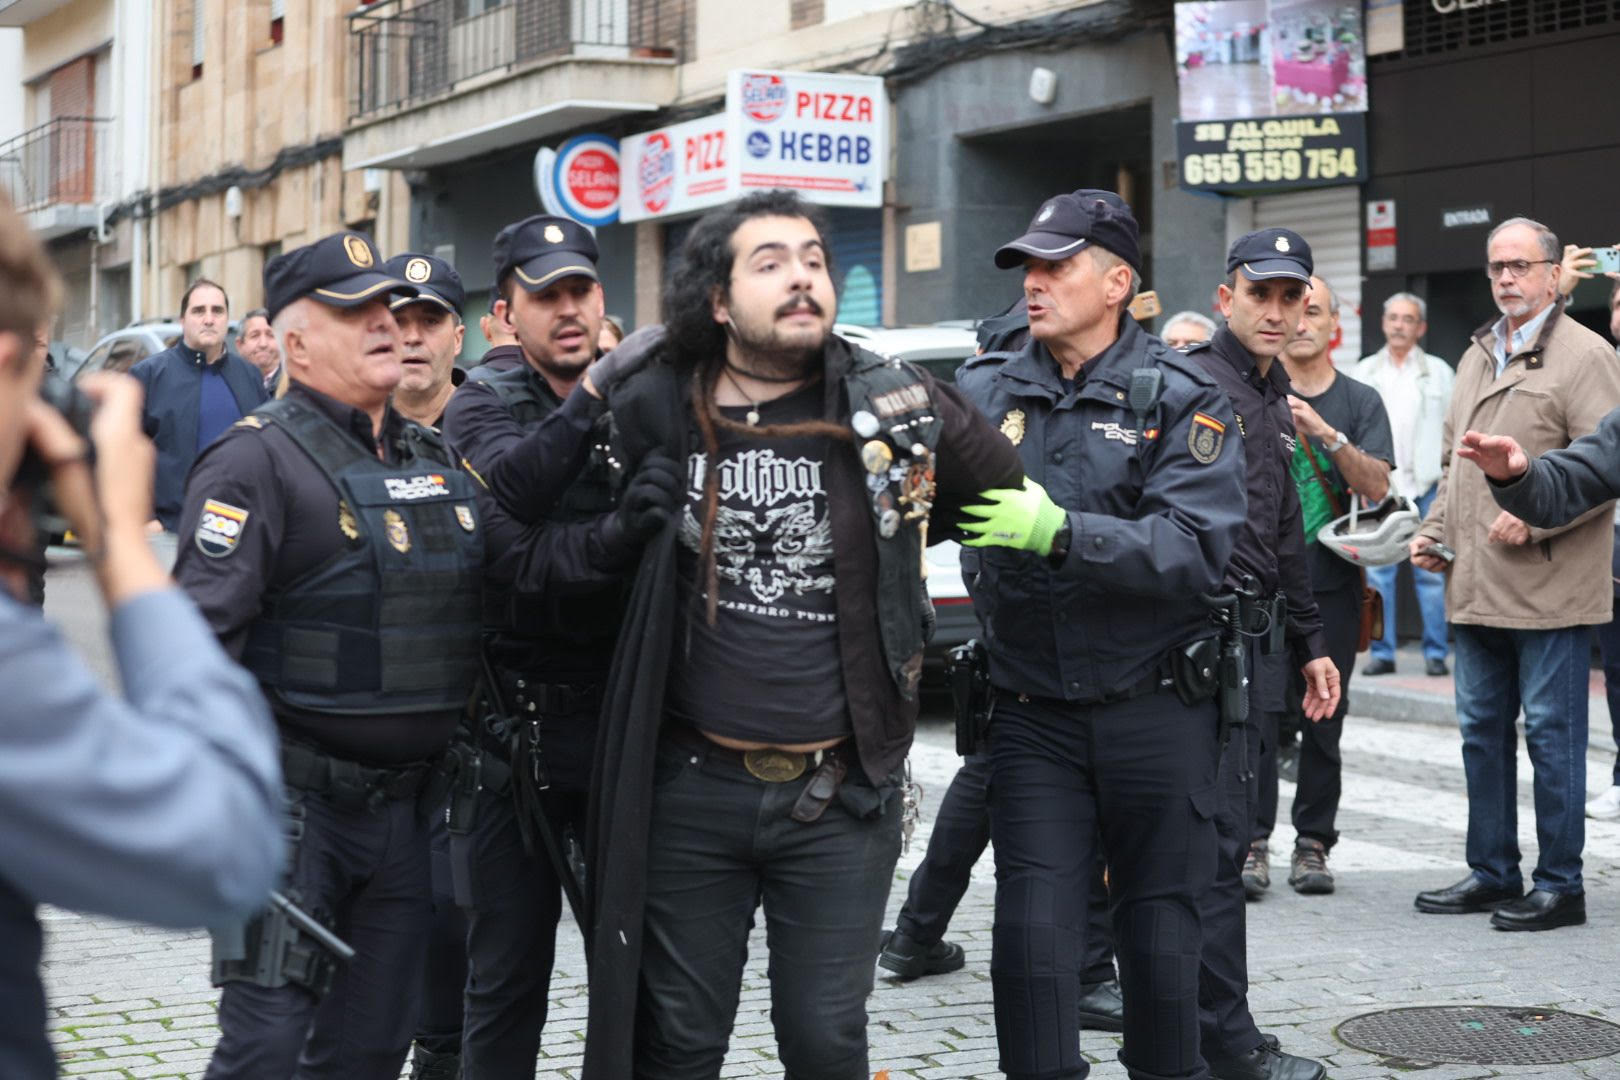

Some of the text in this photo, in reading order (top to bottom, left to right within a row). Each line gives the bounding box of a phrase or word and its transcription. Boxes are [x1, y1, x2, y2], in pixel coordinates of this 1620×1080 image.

[796, 91, 873, 122] PIZZA
[1229, 118, 1340, 140] ALQUILA
[780, 131, 871, 165] KEBAB
[1184, 147, 1357, 185] 655 559 754
